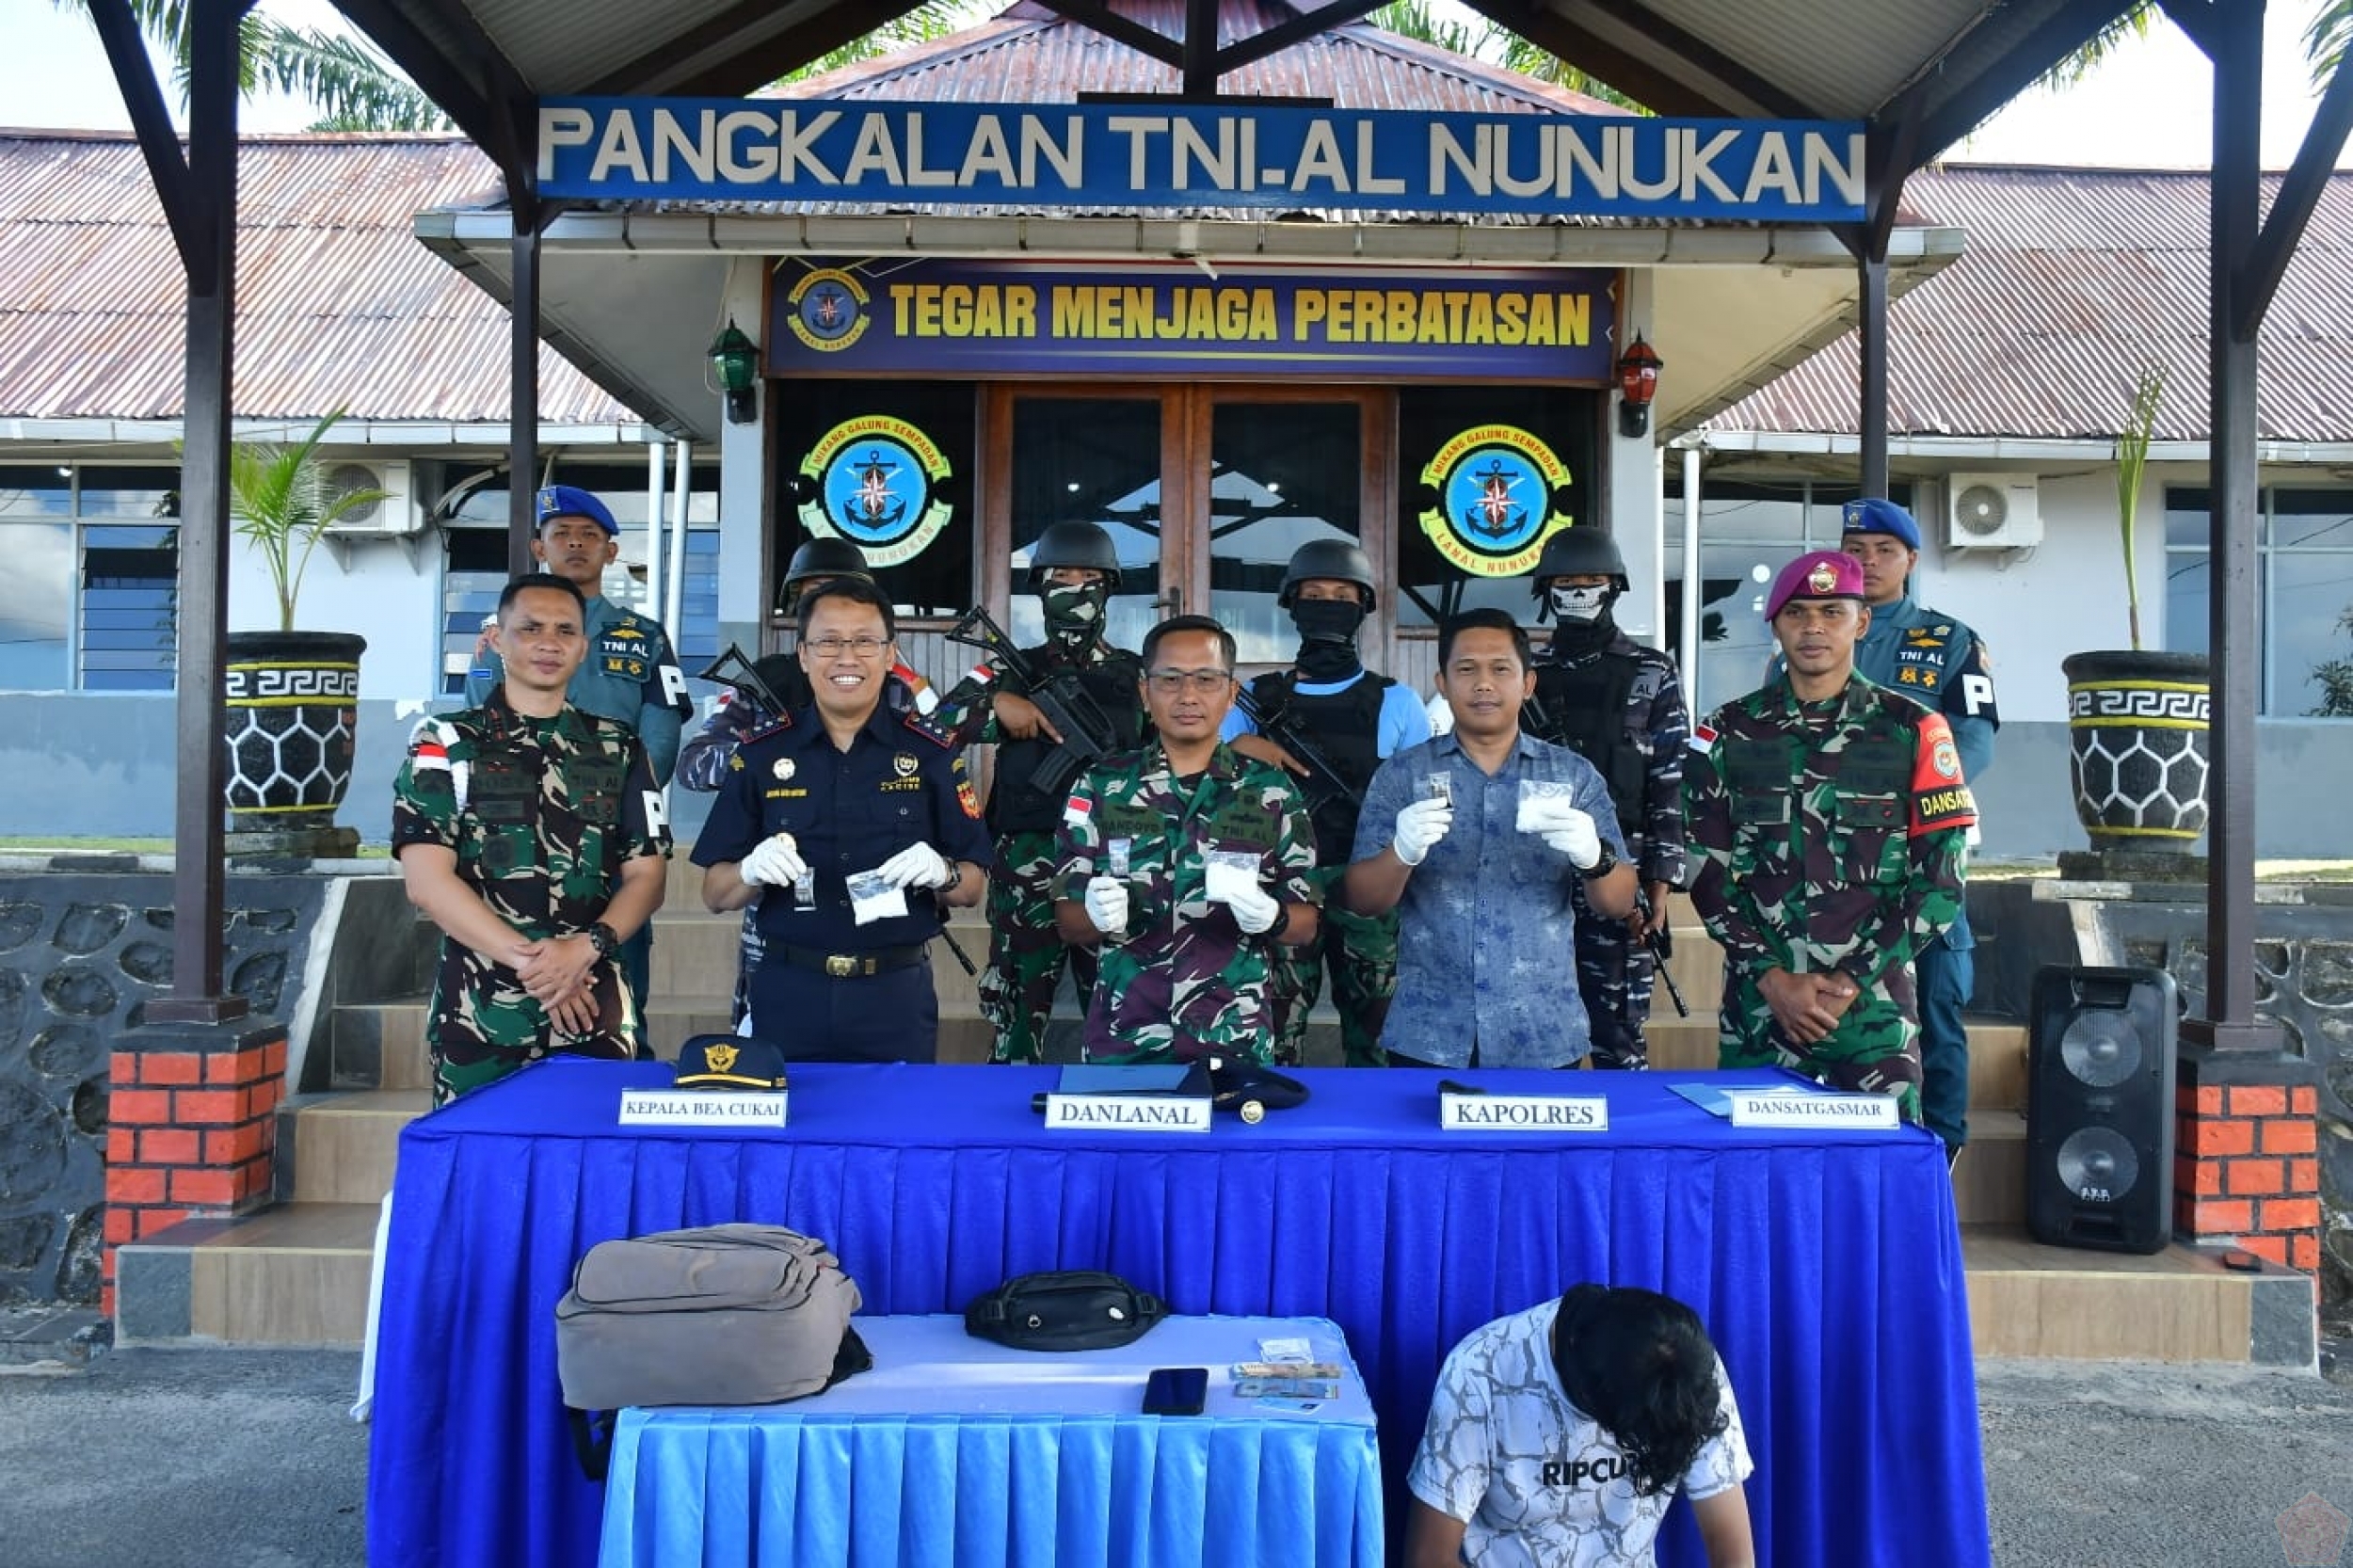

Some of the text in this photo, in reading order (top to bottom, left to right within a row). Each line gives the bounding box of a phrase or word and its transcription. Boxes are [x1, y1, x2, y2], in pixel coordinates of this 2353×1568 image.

[537, 106, 1865, 206] PANGKALAN TNI-AL NUNUKAN
[889, 284, 1036, 339] TEGAR
[1051, 286, 1279, 343] MENJAGA
[1293, 290, 1592, 346] PERBATASAN
[602, 641, 649, 658] TNI AL
[1899, 651, 1945, 665] TNI AL
[1961, 673, 1994, 715] P
[626, 1100, 780, 1116] KEPALA BEA CUKAI
[1060, 1102, 1198, 1125] DANLANAL
[1456, 1103, 1594, 1125] KAPOLRES
[1748, 1100, 1882, 1116] DANSATGASMAR
